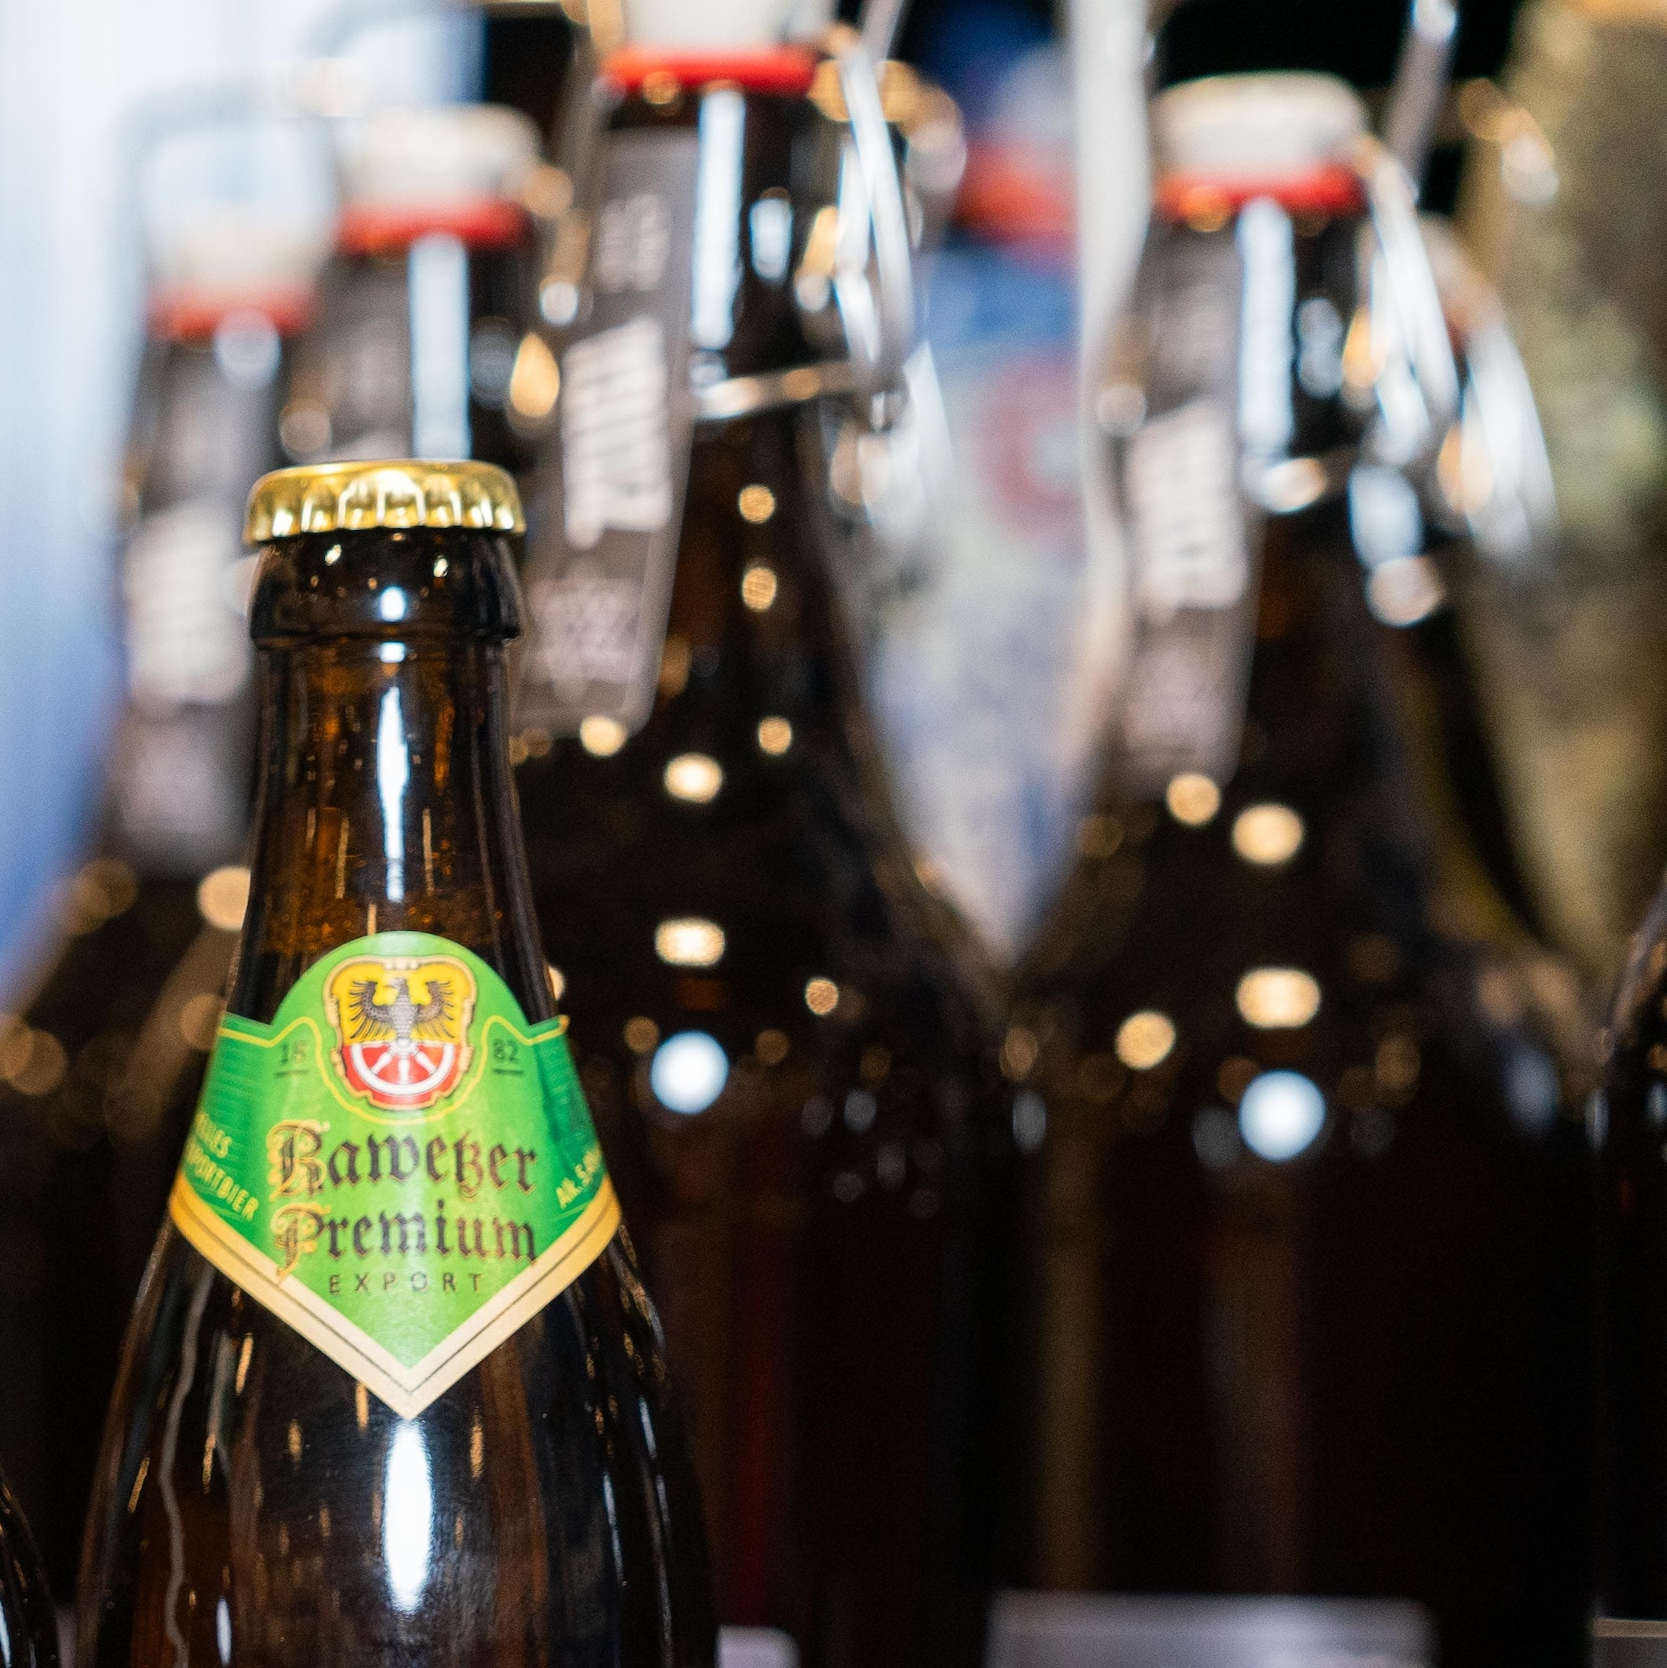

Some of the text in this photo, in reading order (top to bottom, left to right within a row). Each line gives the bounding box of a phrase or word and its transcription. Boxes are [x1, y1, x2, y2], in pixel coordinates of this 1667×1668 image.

[492, 1038, 520, 1063] 82
[271, 1199, 539, 1282] Premium
[328, 1272, 483, 1296] EXPORT
